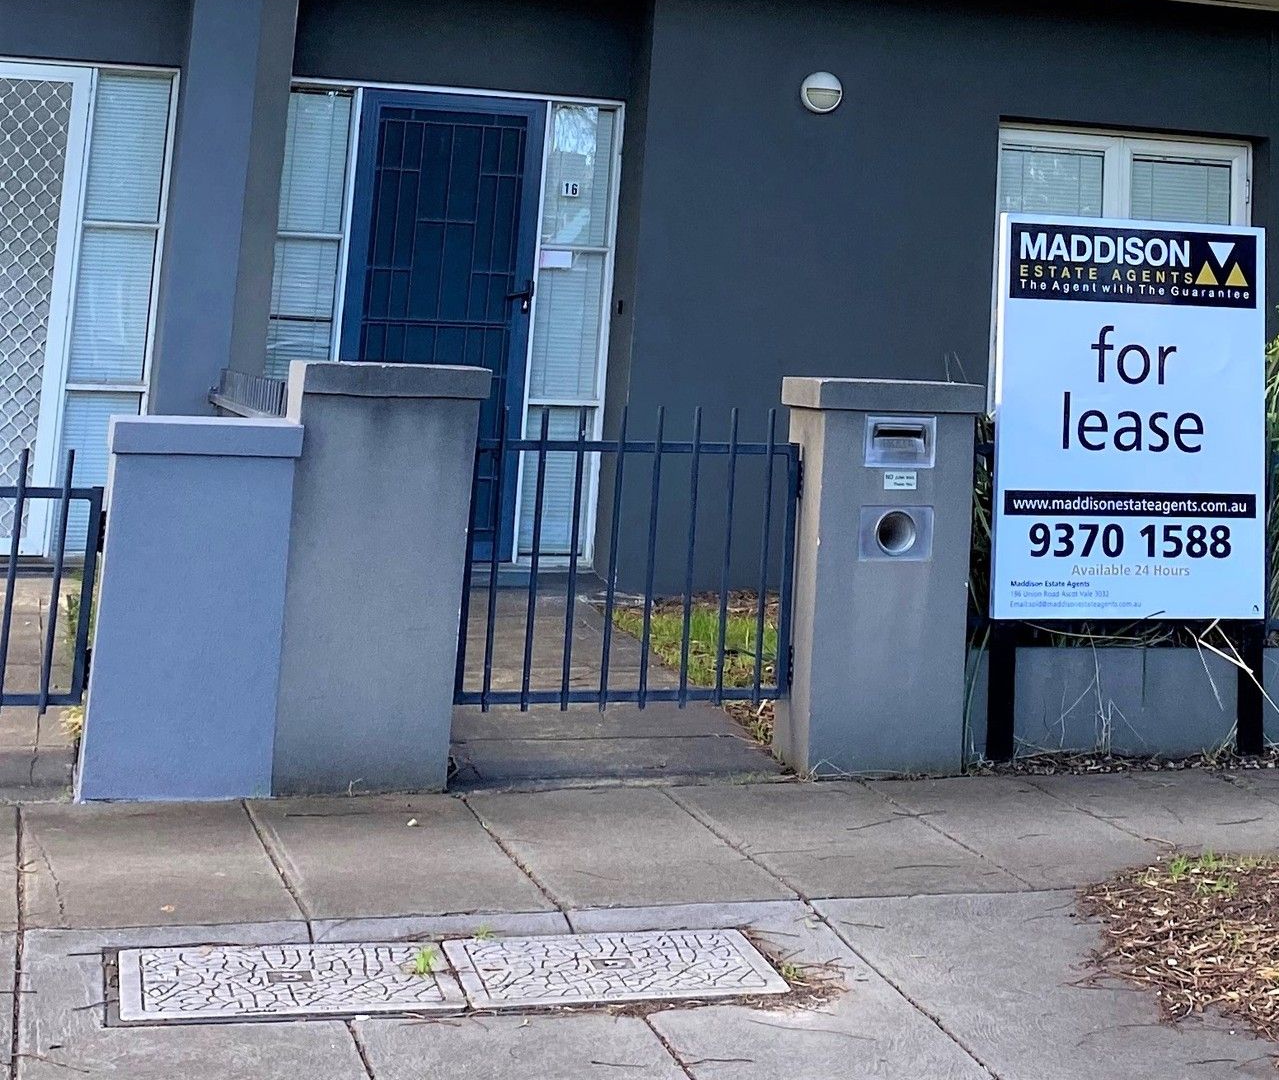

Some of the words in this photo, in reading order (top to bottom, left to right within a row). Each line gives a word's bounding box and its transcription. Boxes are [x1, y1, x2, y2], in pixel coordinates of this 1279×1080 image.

[565, 182, 578, 195] 16
[1020, 231, 1190, 268] MADDISON
[1020, 264, 1098, 280] ESTATE
[1112, 269, 1193, 285] AGENTS
[1020, 278, 1047, 291] The
[1052, 280, 1097, 294] Agent
[1102, 282, 1133, 294] with
[1139, 284, 1165, 296] The
[1171, 286, 1250, 300] Guarantee
[1091, 325, 1177, 385] for
[1062, 391, 1204, 453] lease
[1013, 495, 1248, 514] www.maddisonestateagents.com.au
[1028, 522, 1124, 558] 9370
[1139, 524, 1232, 558] 1588
[1071, 564, 1131, 576] Available
[1135, 564, 1149, 575] 24
[1153, 565, 1190, 577] Hours
[1010, 580, 1043, 588] Maddison
[1045, 580, 1065, 588] Estate
[1067, 580, 1090, 589] Agents
[1044, 590, 1060, 598] Road
